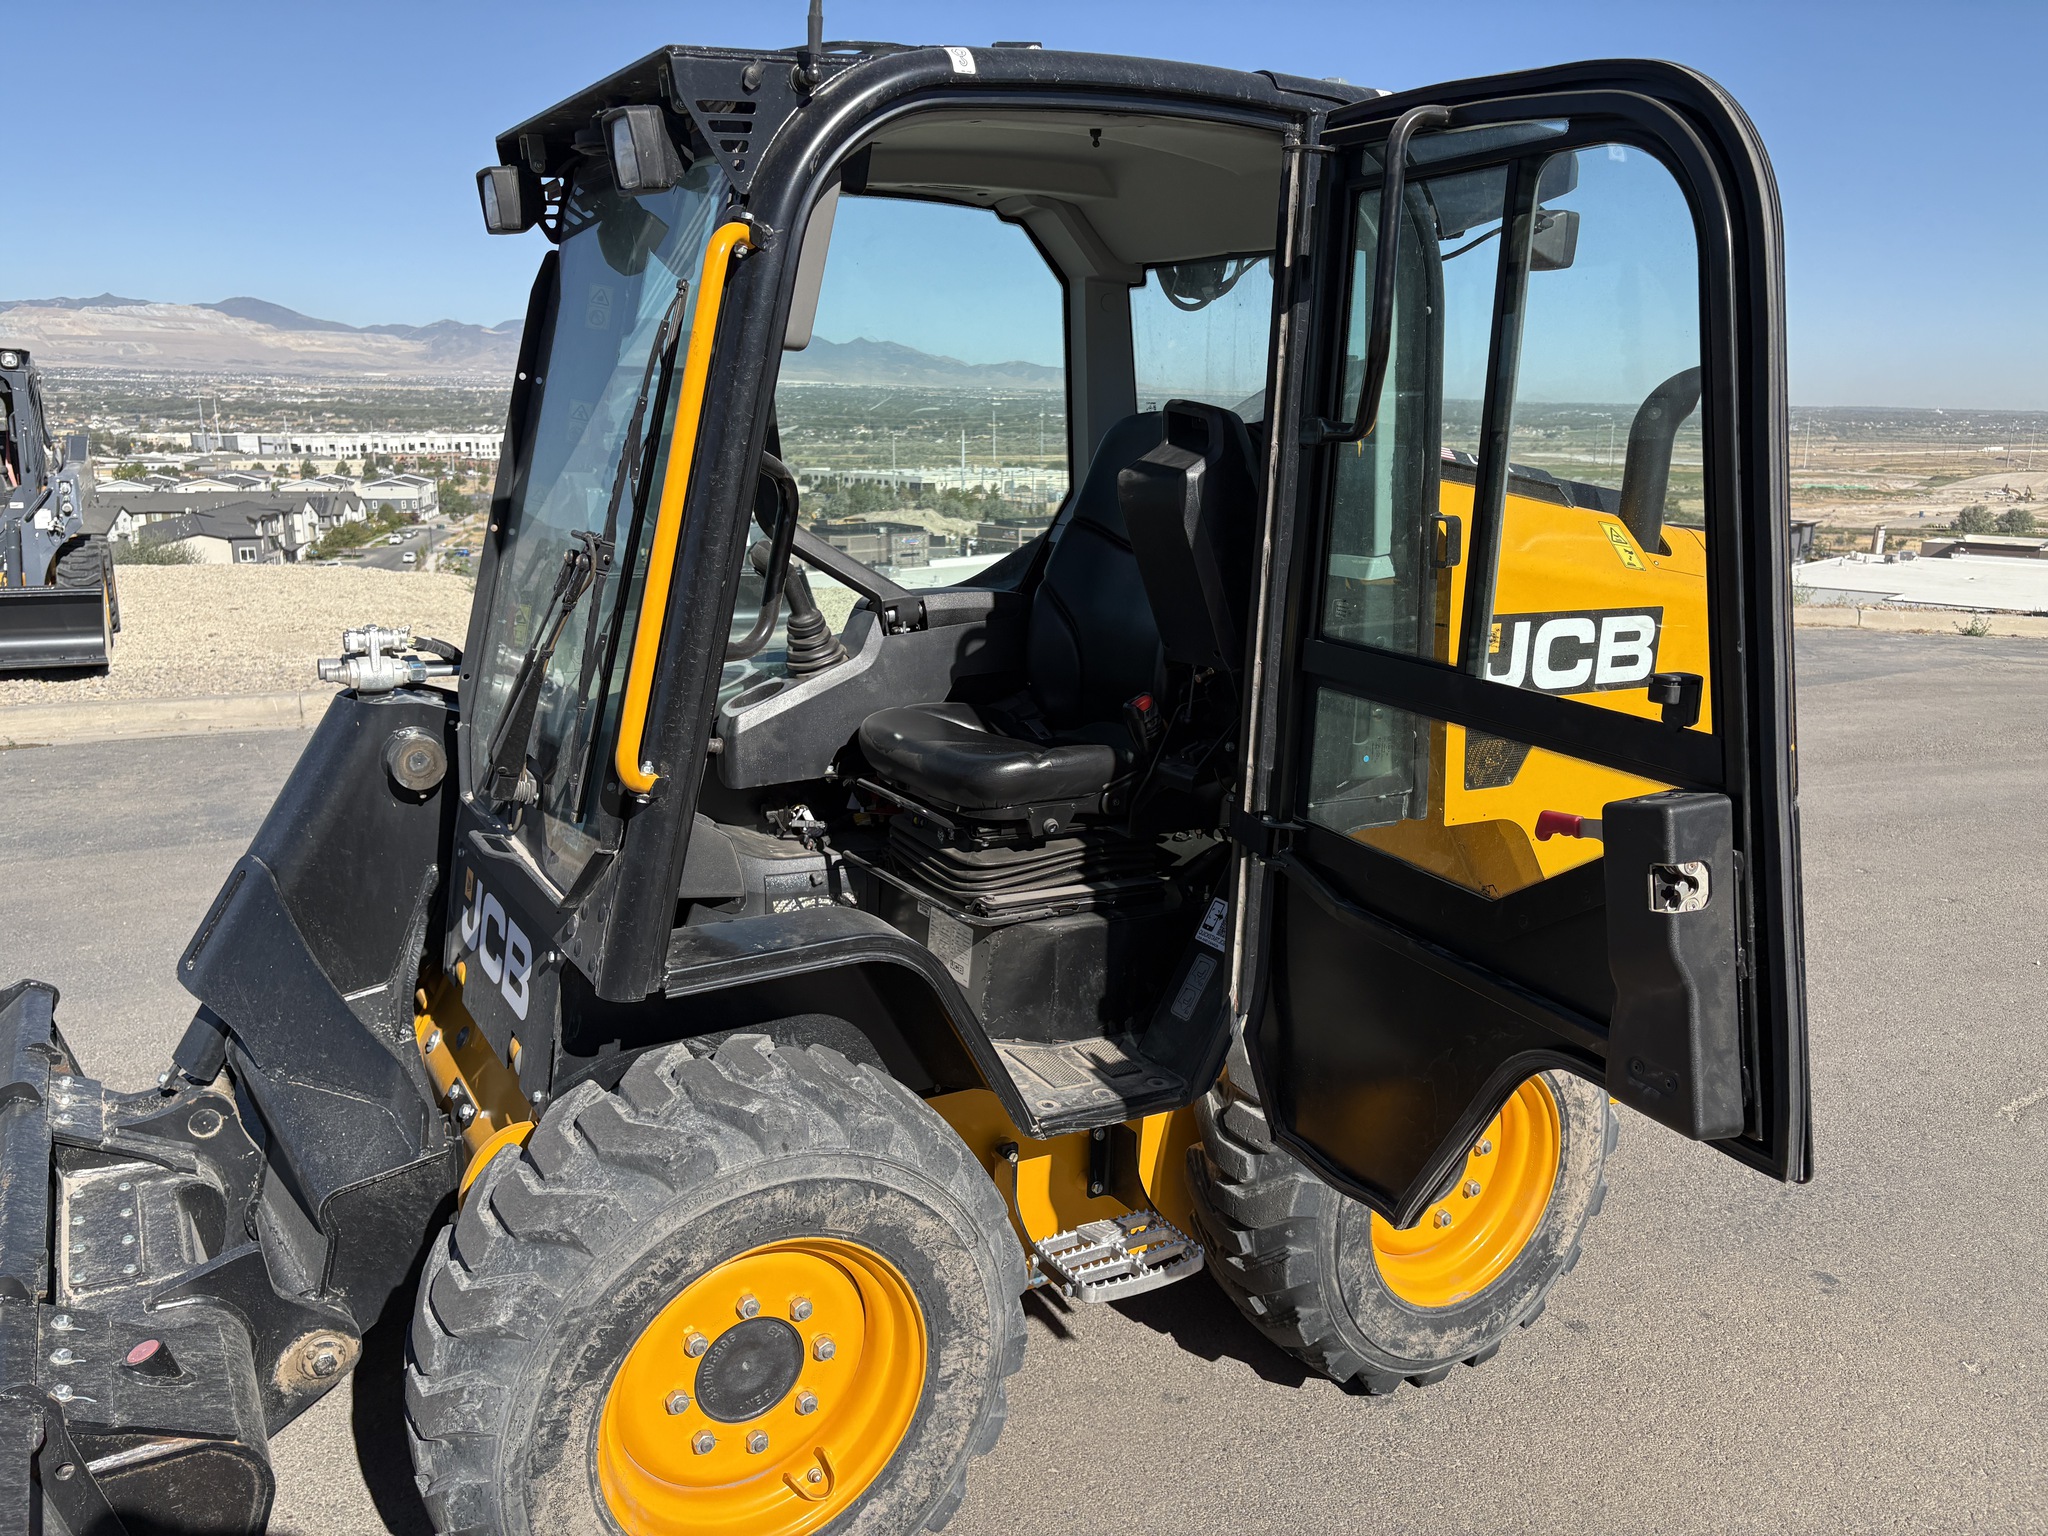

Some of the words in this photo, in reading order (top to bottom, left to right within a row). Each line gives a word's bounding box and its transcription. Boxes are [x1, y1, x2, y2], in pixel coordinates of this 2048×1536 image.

[1485, 615, 1656, 690] JCB
[461, 879, 533, 1021] JCB
[950, 960, 964, 975] JCB
